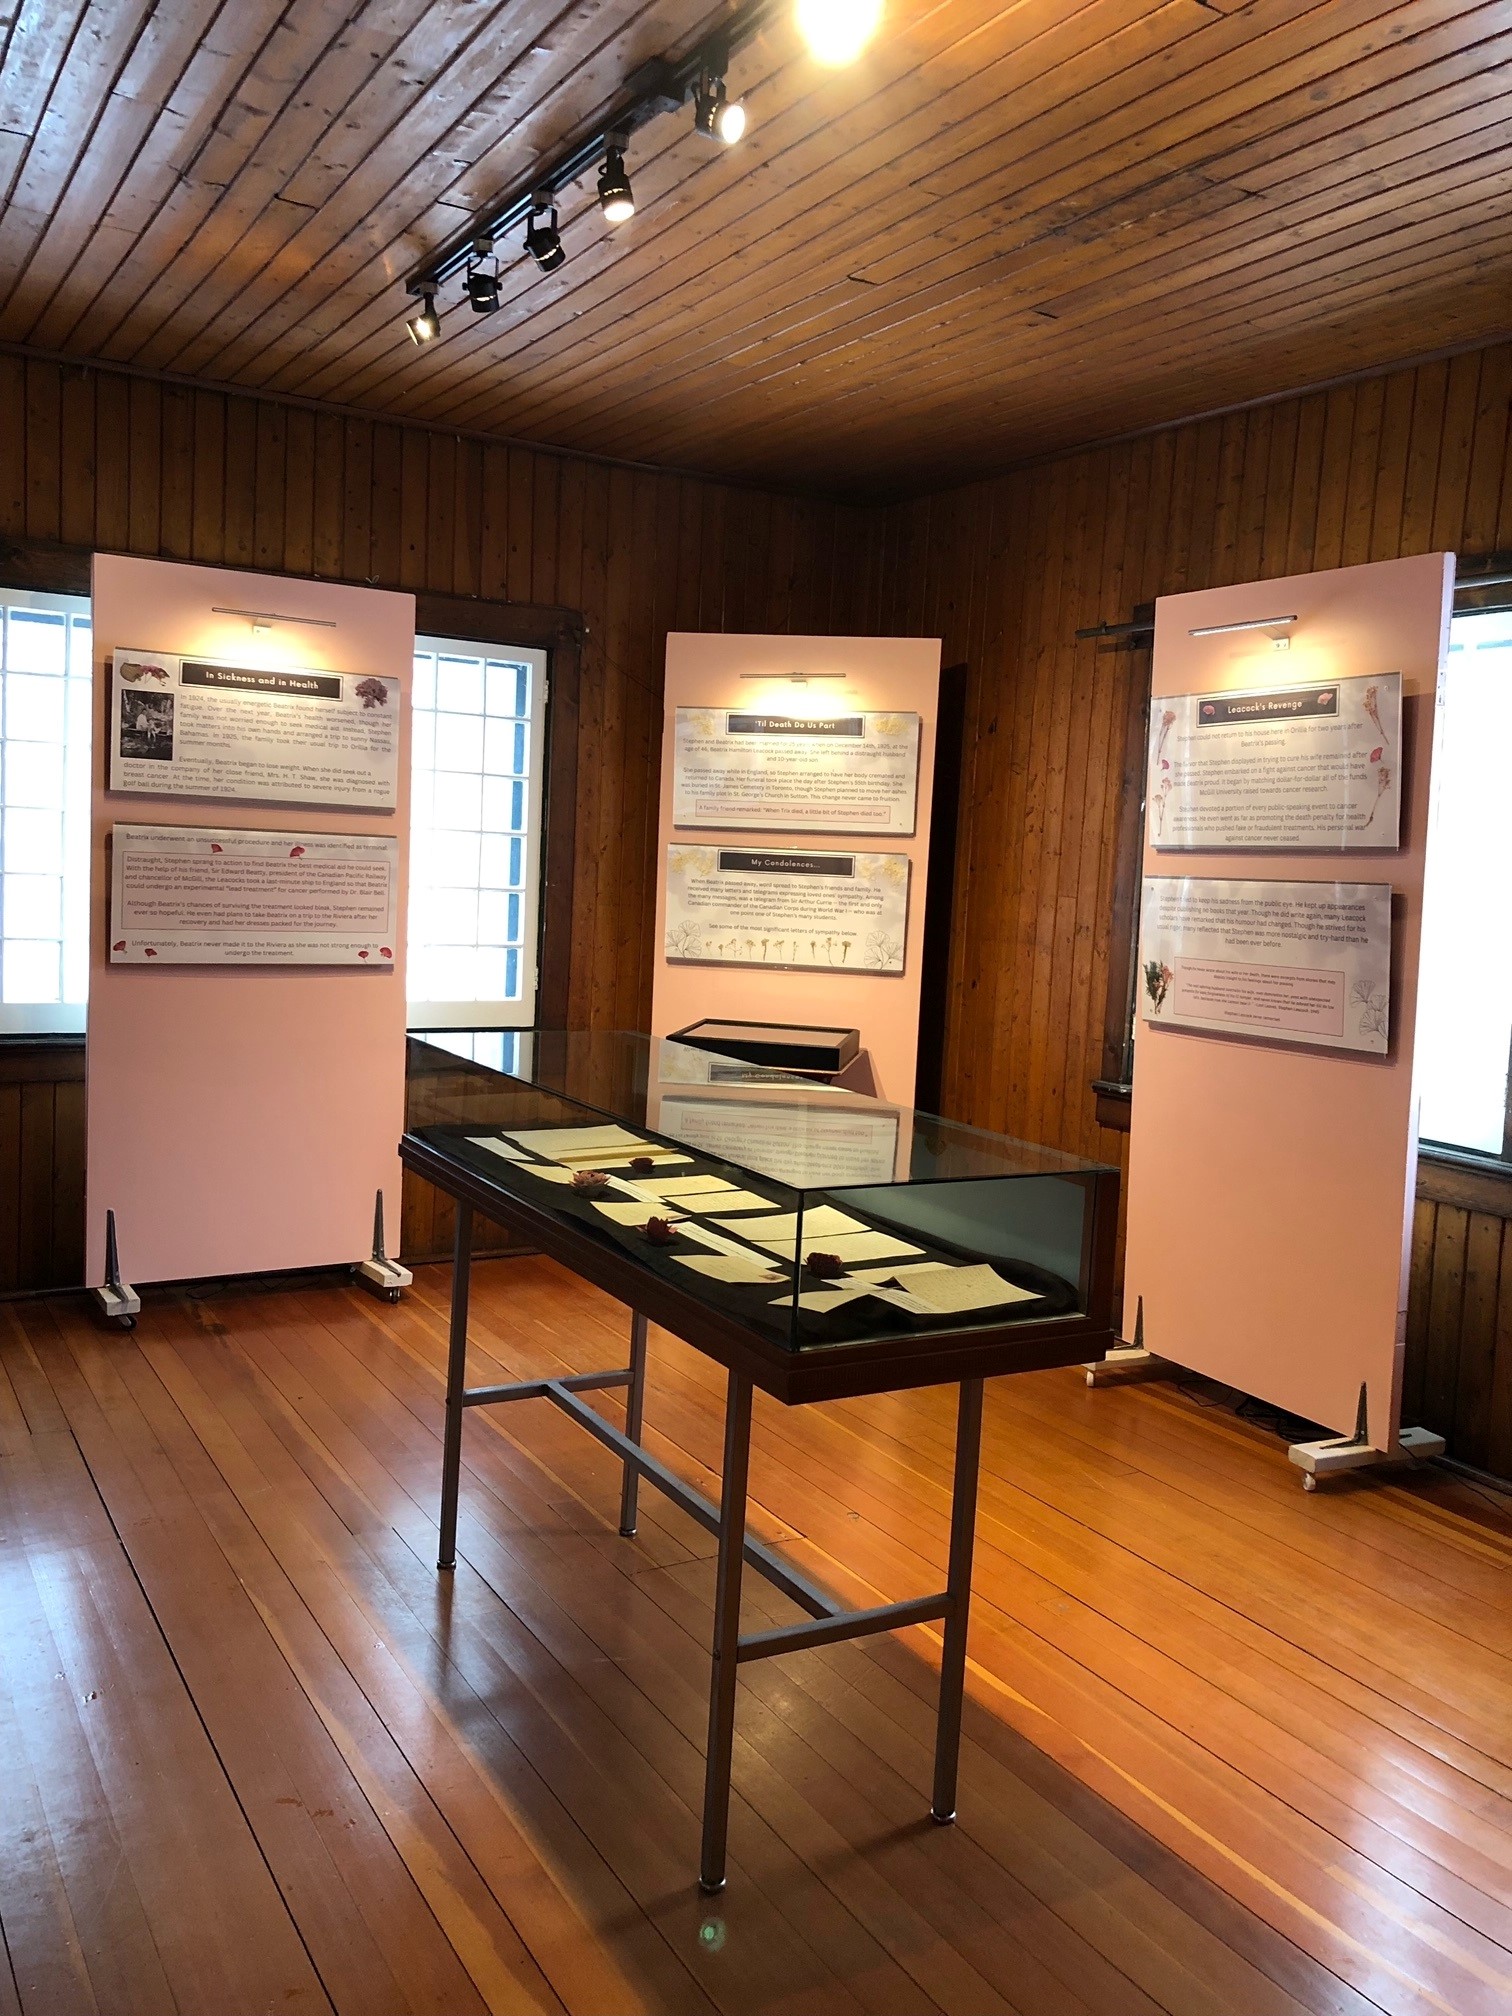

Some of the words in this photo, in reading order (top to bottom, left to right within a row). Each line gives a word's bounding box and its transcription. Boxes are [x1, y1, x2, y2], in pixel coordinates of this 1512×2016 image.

[218, 673, 255, 683] Sickness
[258, 677, 275, 685] and
[289, 680, 319, 689] Health
[1228, 703, 1265, 714] Leacock's
[1268, 699, 1303, 712] Revenge
[238, 760, 257, 769] began
[123, 780, 136, 788] golf
[151, 781, 172, 790] during
[346, 777, 376, 786] diagnosed
[1216, 787, 1242, 797] University
[1252, 909, 1271, 918] Though
[1342, 914, 1366, 922] Leacock
